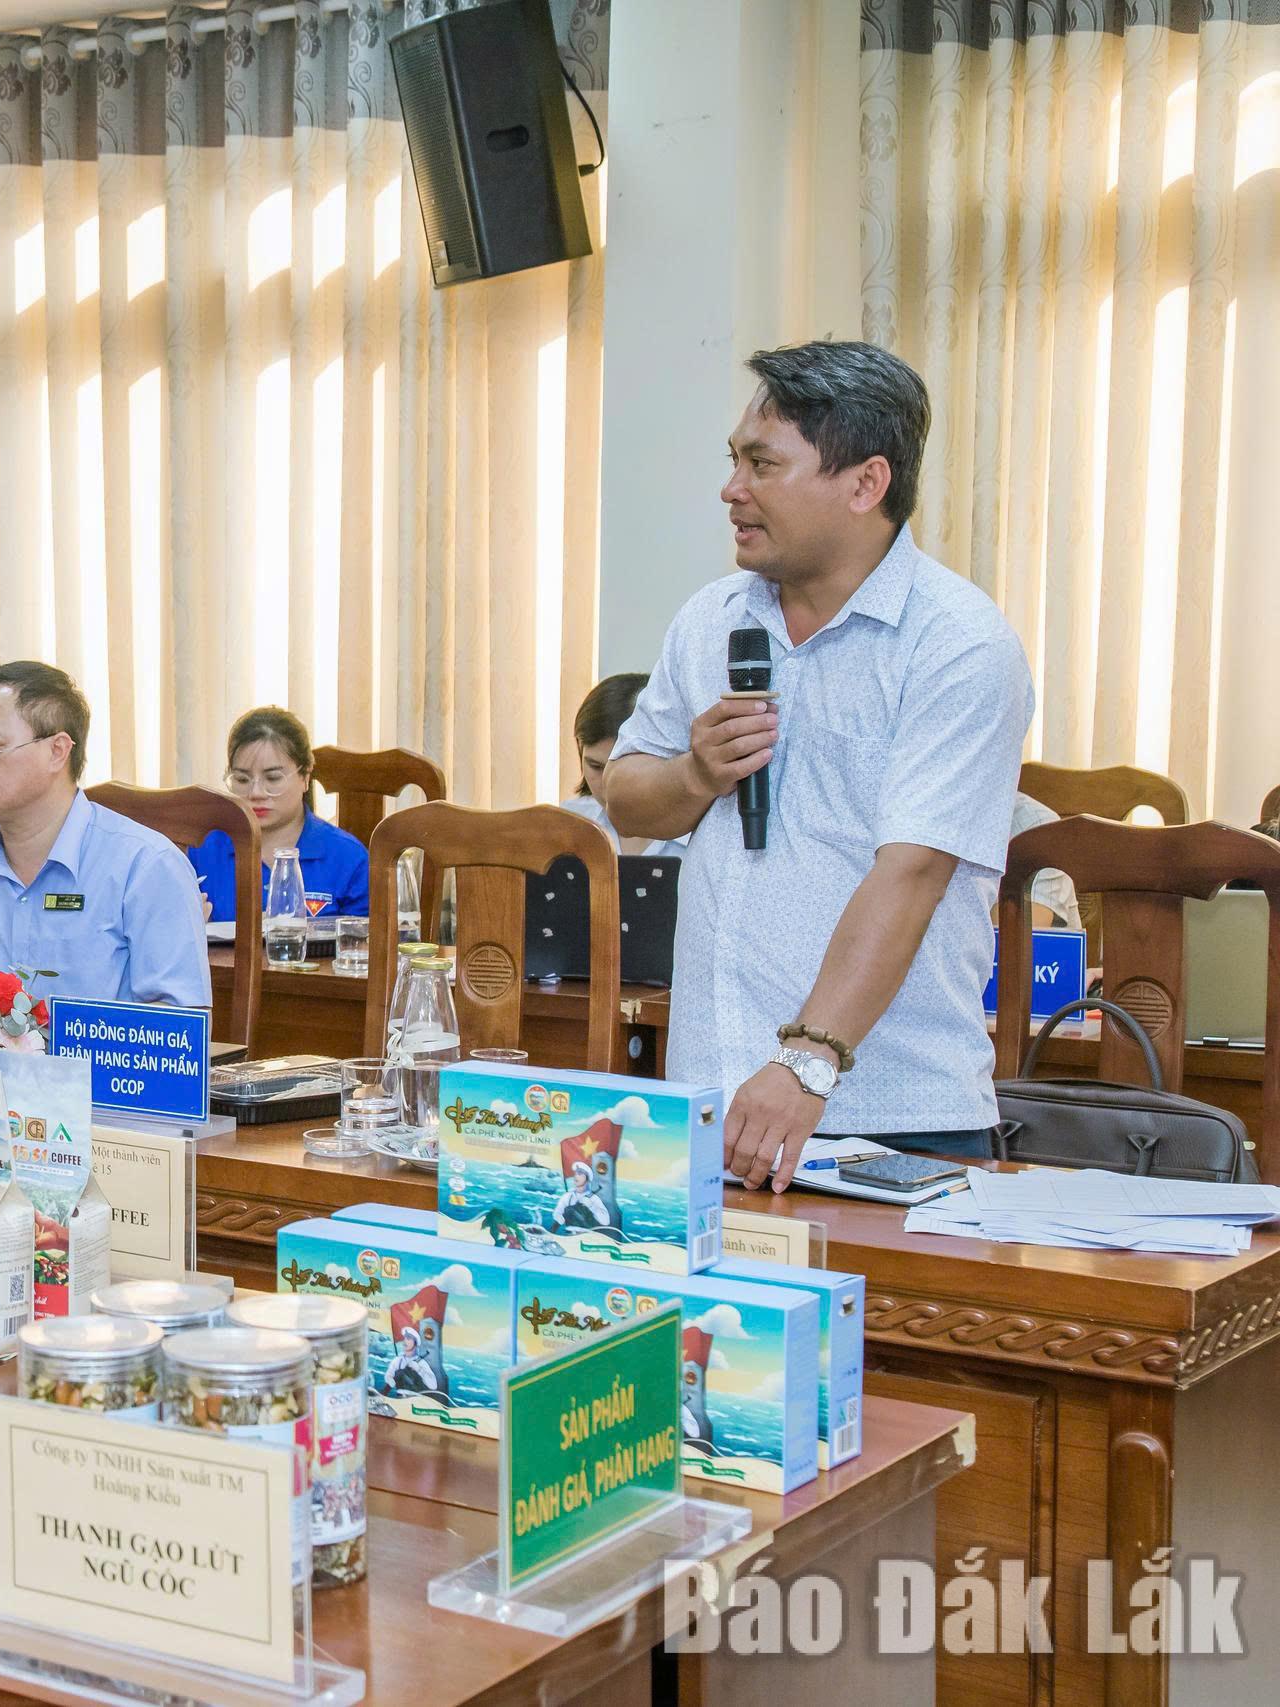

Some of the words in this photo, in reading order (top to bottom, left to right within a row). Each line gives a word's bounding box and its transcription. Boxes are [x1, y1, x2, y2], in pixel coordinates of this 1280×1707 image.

[1034, 962, 1060, 984] KÝ
[65, 1018, 87, 1039] HỘI
[89, 1018, 127, 1043] ĐỒNG
[128, 1022, 164, 1047] ĐÁNH
[166, 1022, 193, 1053] GIÁ,
[95, 1051, 131, 1071] HẠNG
[132, 1048, 158, 1072] SẢN
[161, 1052, 199, 1077] PHẨM
[110, 1078, 145, 1096] OCOP
[51, 1152, 82, 1166] COFFEE
[101, 1164, 112, 1176] 15
[112, 1149, 140, 1163] thành
[141, 1152, 161, 1166] viên
[111, 1207, 150, 1227] FFEE
[750, 1241, 777, 1257] viên
[559, 1396, 590, 1450] SẢN
[592, 1374, 635, 1435] PHẨM
[31, 1438, 72, 1465] Công
[73, 1448, 89, 1468] ty
[92, 1449, 143, 1474] TNHH
[147, 1457, 175, 1480] Sản
[180, 1462, 212, 1487] xuất
[216, 1472, 244, 1494] TM
[93, 1474, 141, 1502] Hoàng
[515, 1482, 561, 1537] ĐÁNH
[594, 1441, 634, 1496] PHÂN
[636, 1425, 676, 1477] HẠNG
[37, 1514, 122, 1551] THANH
[130, 1532, 184, 1566] GẠO
[191, 1542, 245, 1576] LỨT
[83, 1555, 135, 1587] NGŨ
[141, 1564, 197, 1599] CỐC
